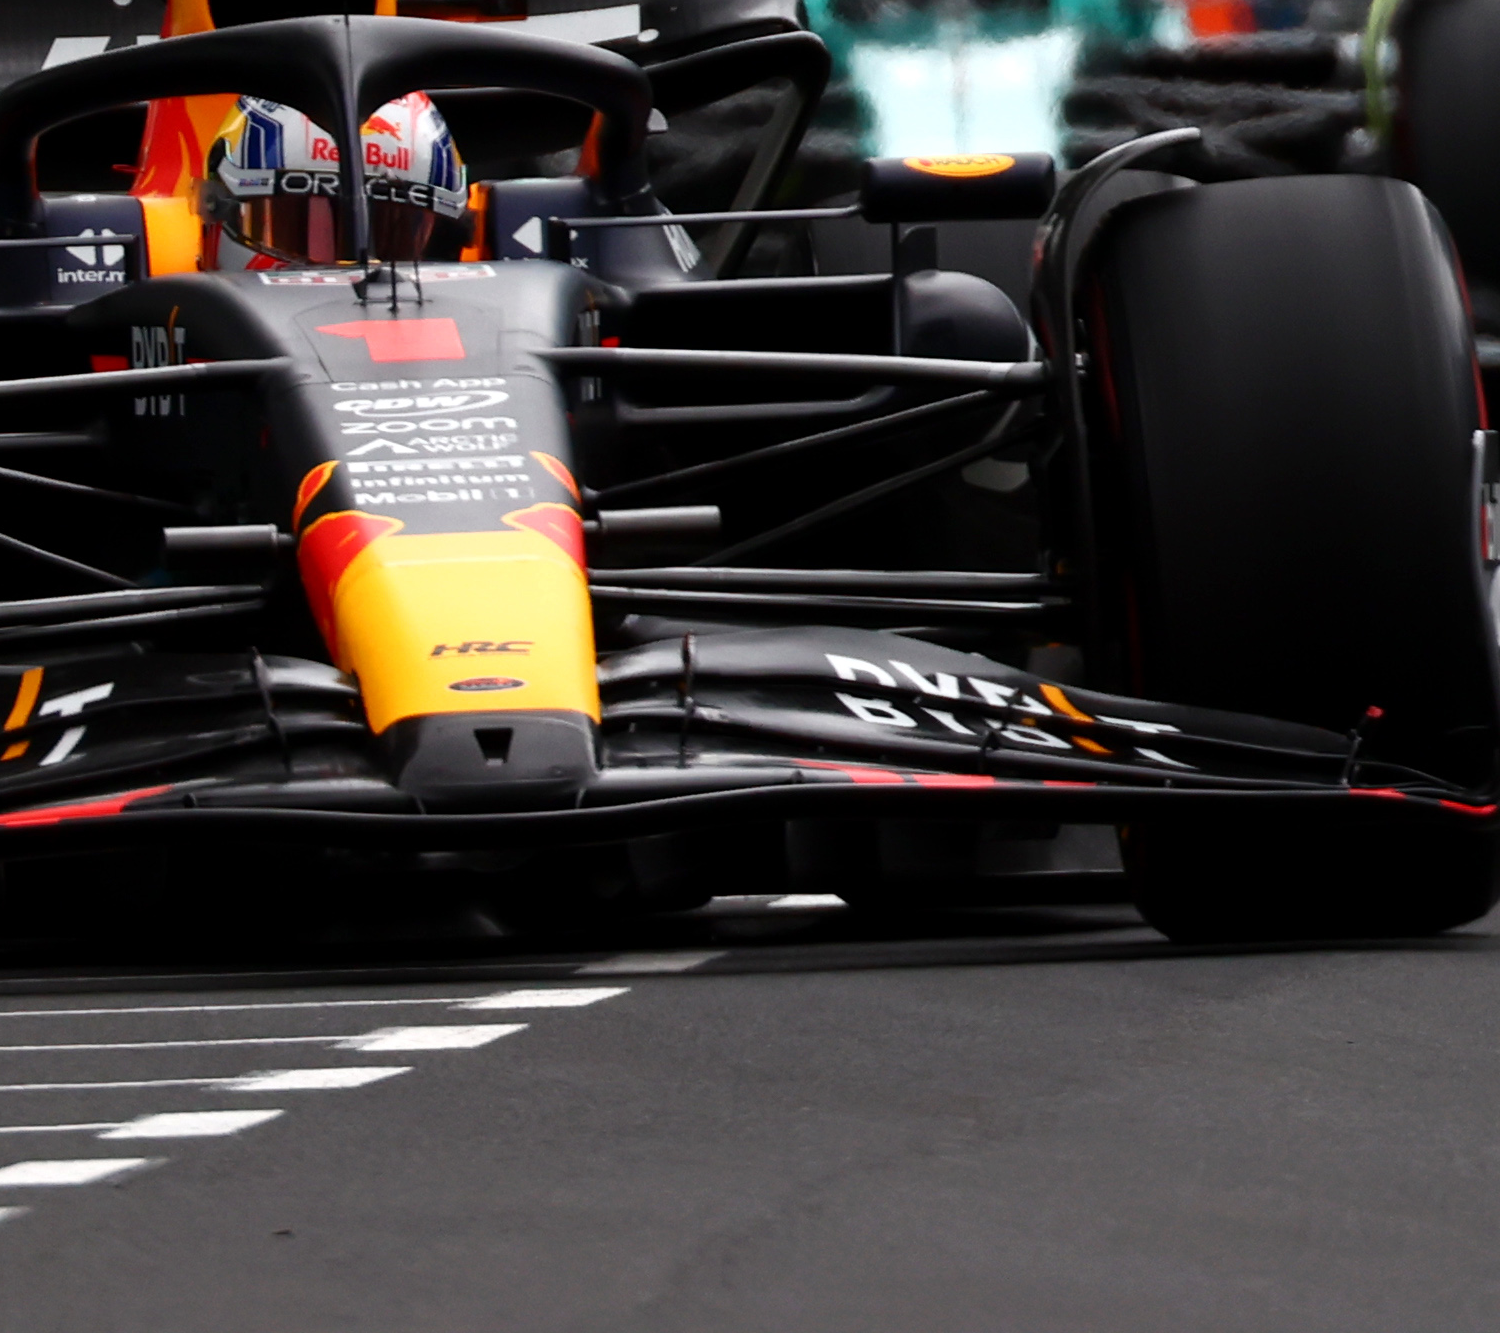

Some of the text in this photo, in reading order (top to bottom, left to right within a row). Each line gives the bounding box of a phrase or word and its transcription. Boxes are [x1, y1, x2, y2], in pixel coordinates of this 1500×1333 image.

[311, 137, 410, 171] Re Bull
[281, 171, 430, 208] ORCLE
[314, 316, 467, 363] 1
[331, 377, 507, 392] Cash App
[333, 394, 478, 412] CDW
[340, 416, 517, 434] zoom
[408, 433, 518, 445] ARCTIC
[354, 487, 484, 506] Mobil
[431, 640, 535, 657] HRC
